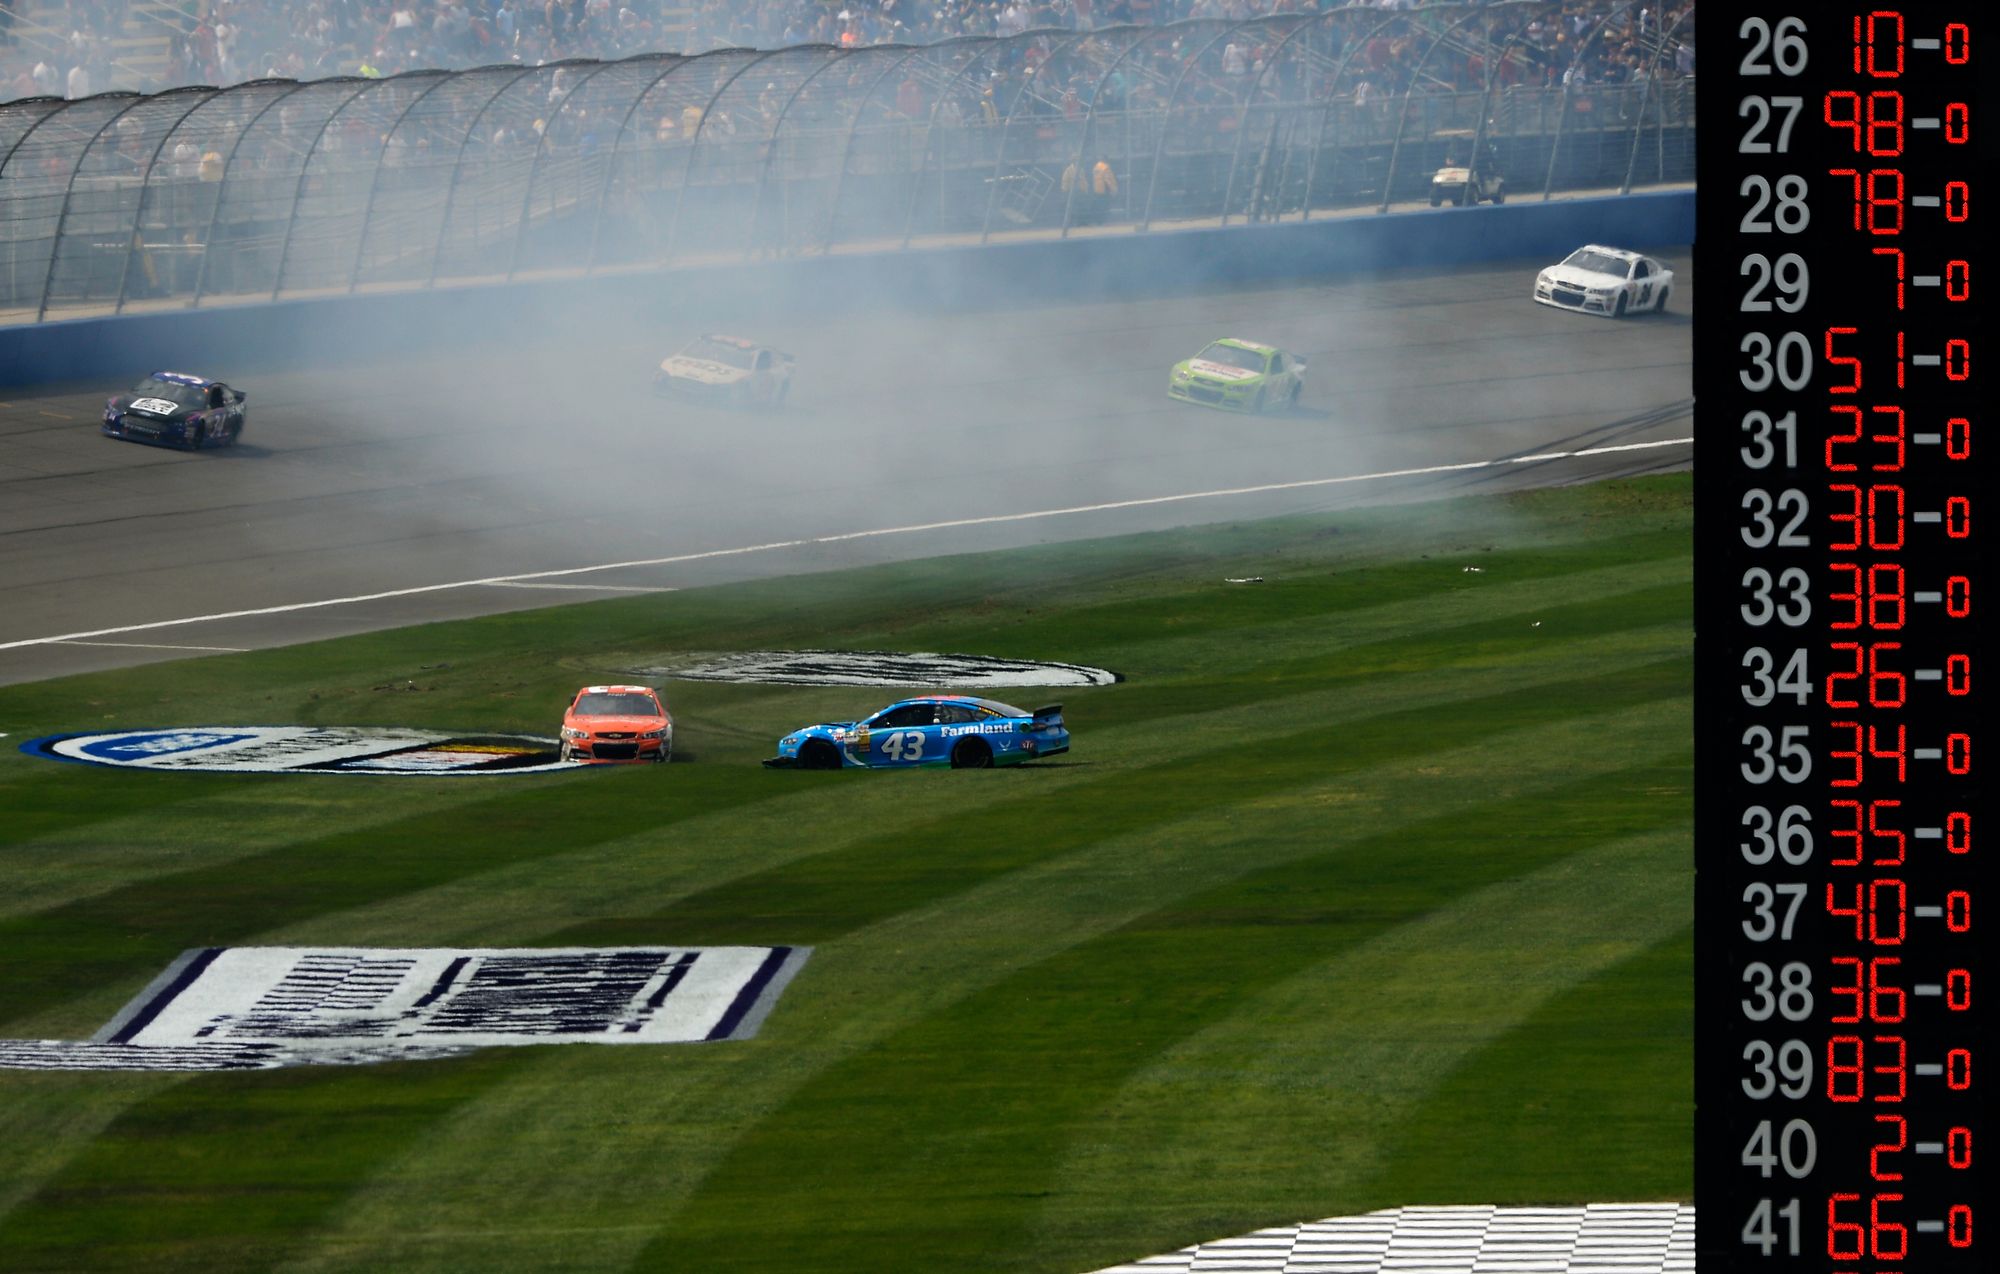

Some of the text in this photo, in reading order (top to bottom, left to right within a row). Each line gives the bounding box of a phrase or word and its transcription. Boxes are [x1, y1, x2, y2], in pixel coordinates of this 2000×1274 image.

[1740, 17, 1809, 77] 26
[1739, 96, 1803, 154] 27
[1740, 175, 1811, 234] 28
[1741, 253, 1810, 314] 29
[1740, 332, 1813, 392] 30
[1741, 411, 1797, 470] 31
[1741, 489, 1811, 549] 32
[1741, 567, 1812, 627] 33
[1741, 647, 1814, 707] 34
[880, 730, 926, 761] 43
[941, 721, 1013, 738] Farmland
[1741, 725, 1812, 785] 35
[1741, 805, 1814, 866] 36
[1742, 883, 1808, 942] 37
[1742, 962, 1814, 1022] 38
[1742, 1040, 1814, 1100] 39
[1742, 1119, 1817, 1179] 40
[1742, 1199, 1800, 1256] 41
